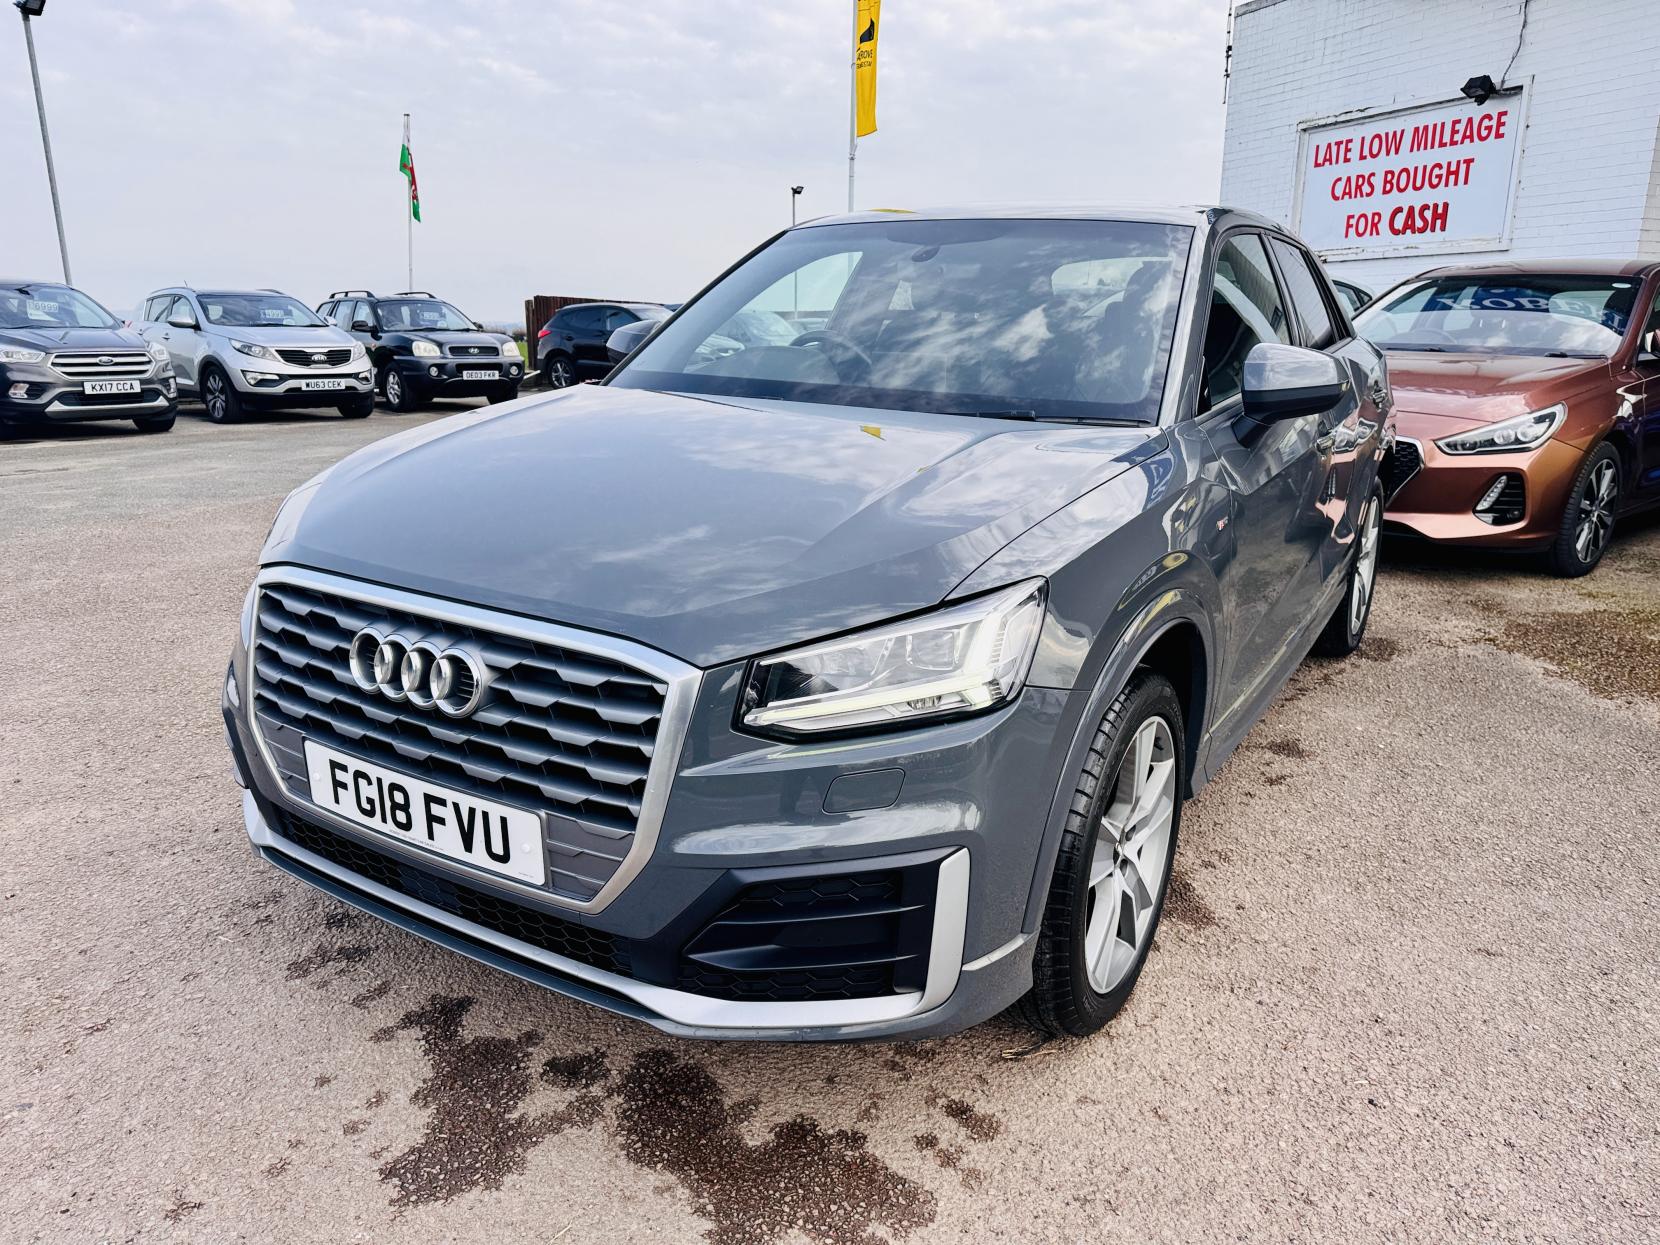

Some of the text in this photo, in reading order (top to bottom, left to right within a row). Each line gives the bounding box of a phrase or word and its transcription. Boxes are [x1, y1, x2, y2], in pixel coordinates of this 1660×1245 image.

[1313, 110, 1509, 168] LATE LOW MILEAGE
[1330, 157, 1475, 201] CARS BOUGHT
[1344, 201, 1449, 239] FOR CASH
[91, 382, 135, 392] KX17 CCA
[327, 380, 342, 388] CEK
[328, 758, 511, 864] FG18 FVU
